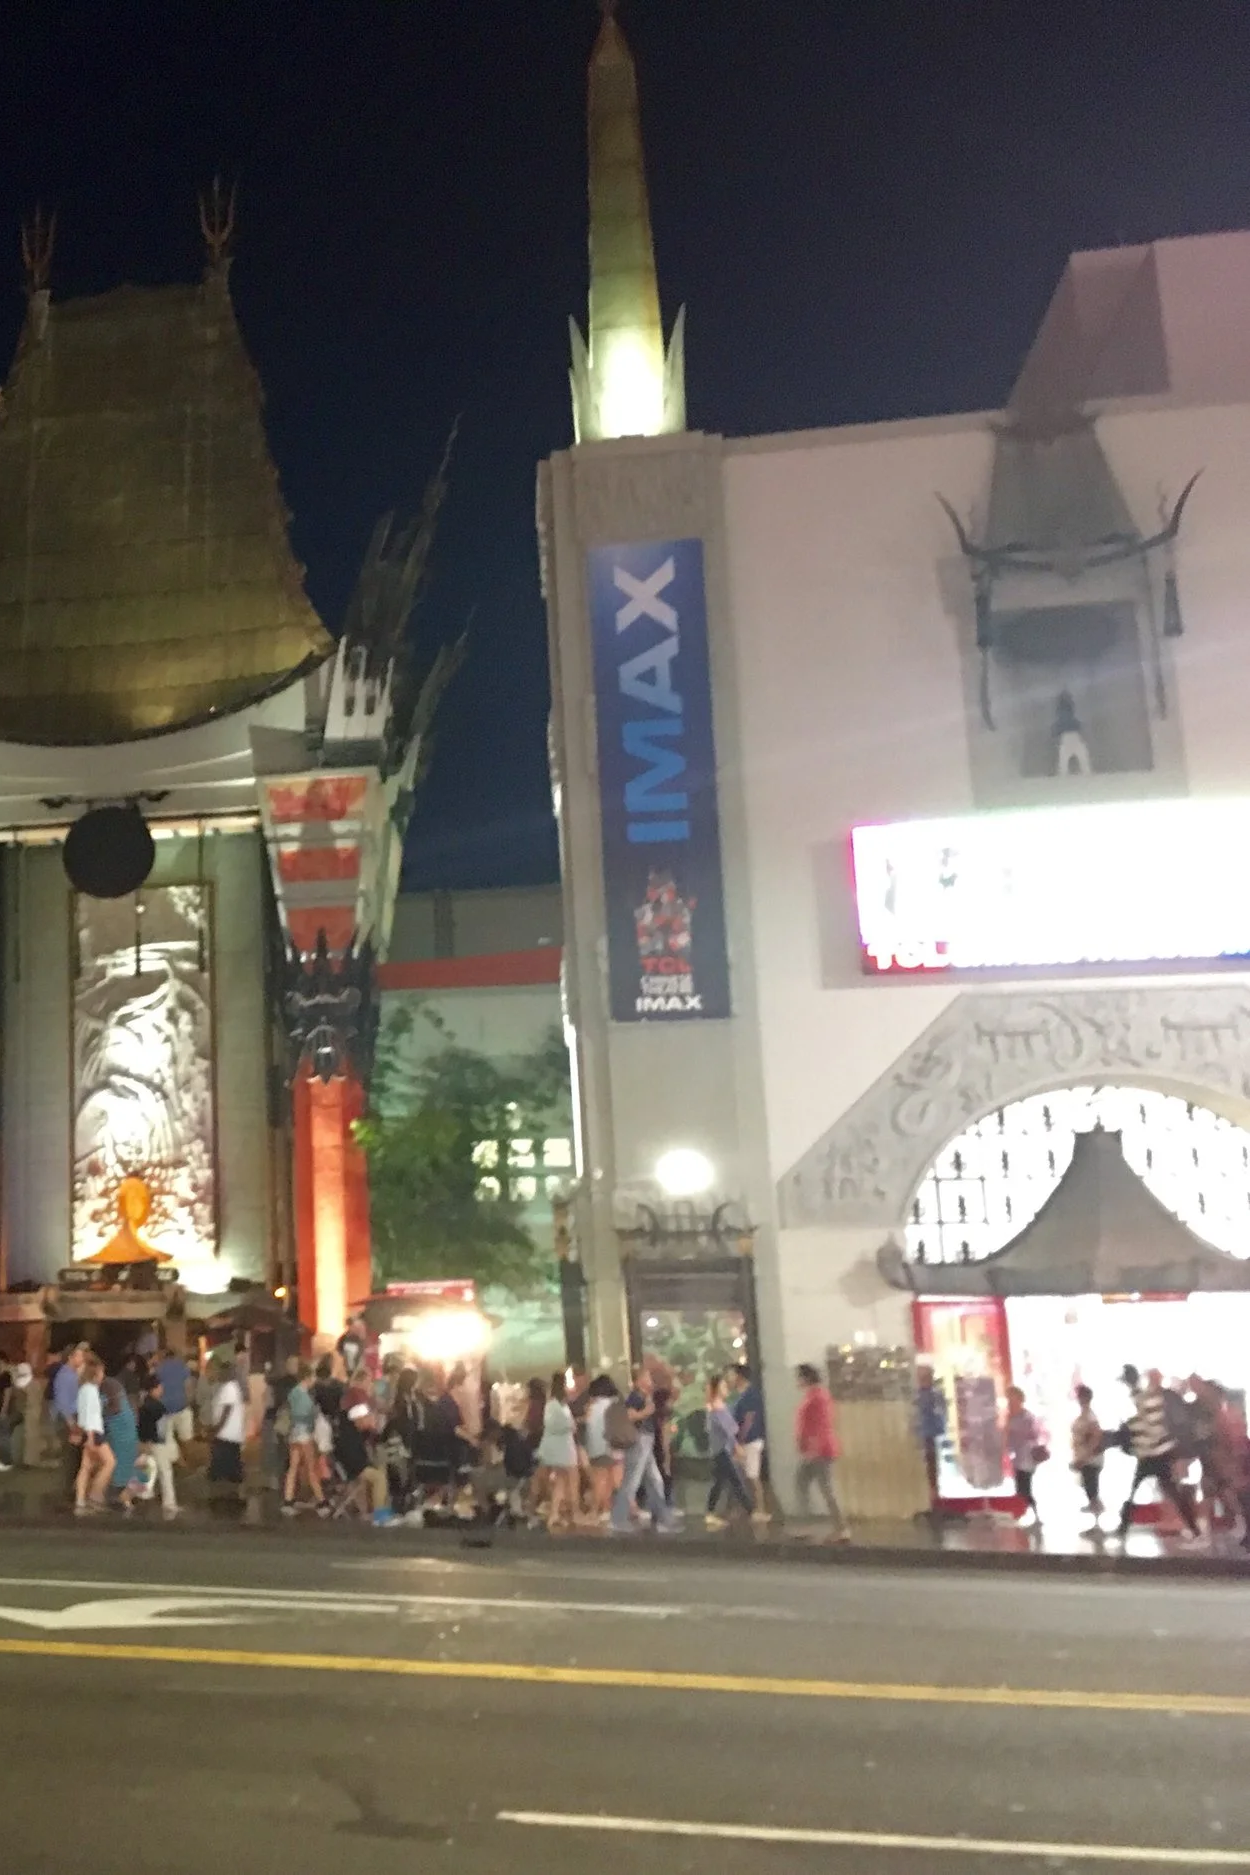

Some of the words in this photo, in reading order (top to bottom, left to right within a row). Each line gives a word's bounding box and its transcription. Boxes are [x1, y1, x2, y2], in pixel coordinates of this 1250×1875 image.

[613, 555, 690, 843] IMAX
[640, 955, 692, 973] TCL
[635, 994, 702, 1012] IMAX
